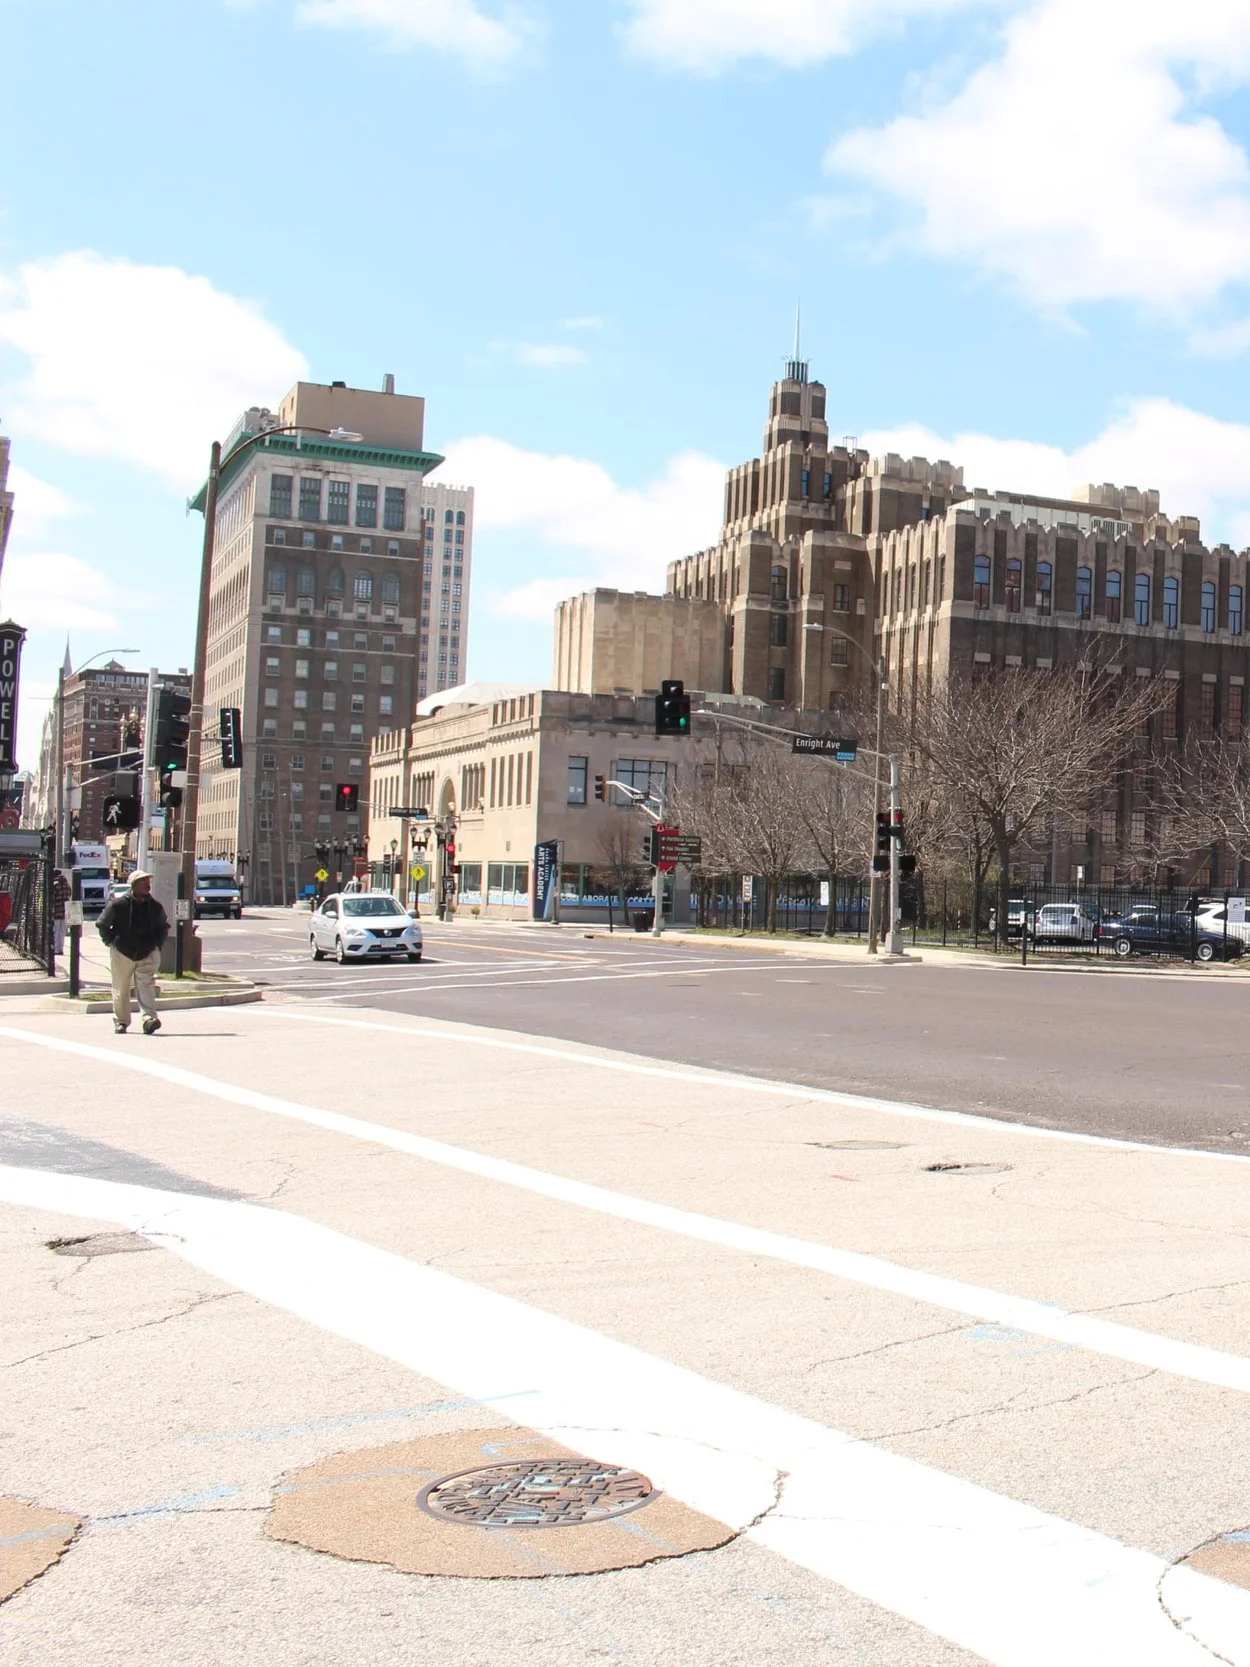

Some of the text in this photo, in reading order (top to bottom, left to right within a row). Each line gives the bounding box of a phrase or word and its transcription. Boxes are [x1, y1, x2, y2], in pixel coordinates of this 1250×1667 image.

[0, 639, 15, 762] POWELL
[796, 738, 841, 749] Enright Ave
[536, 866, 545, 900] ACADEMY
